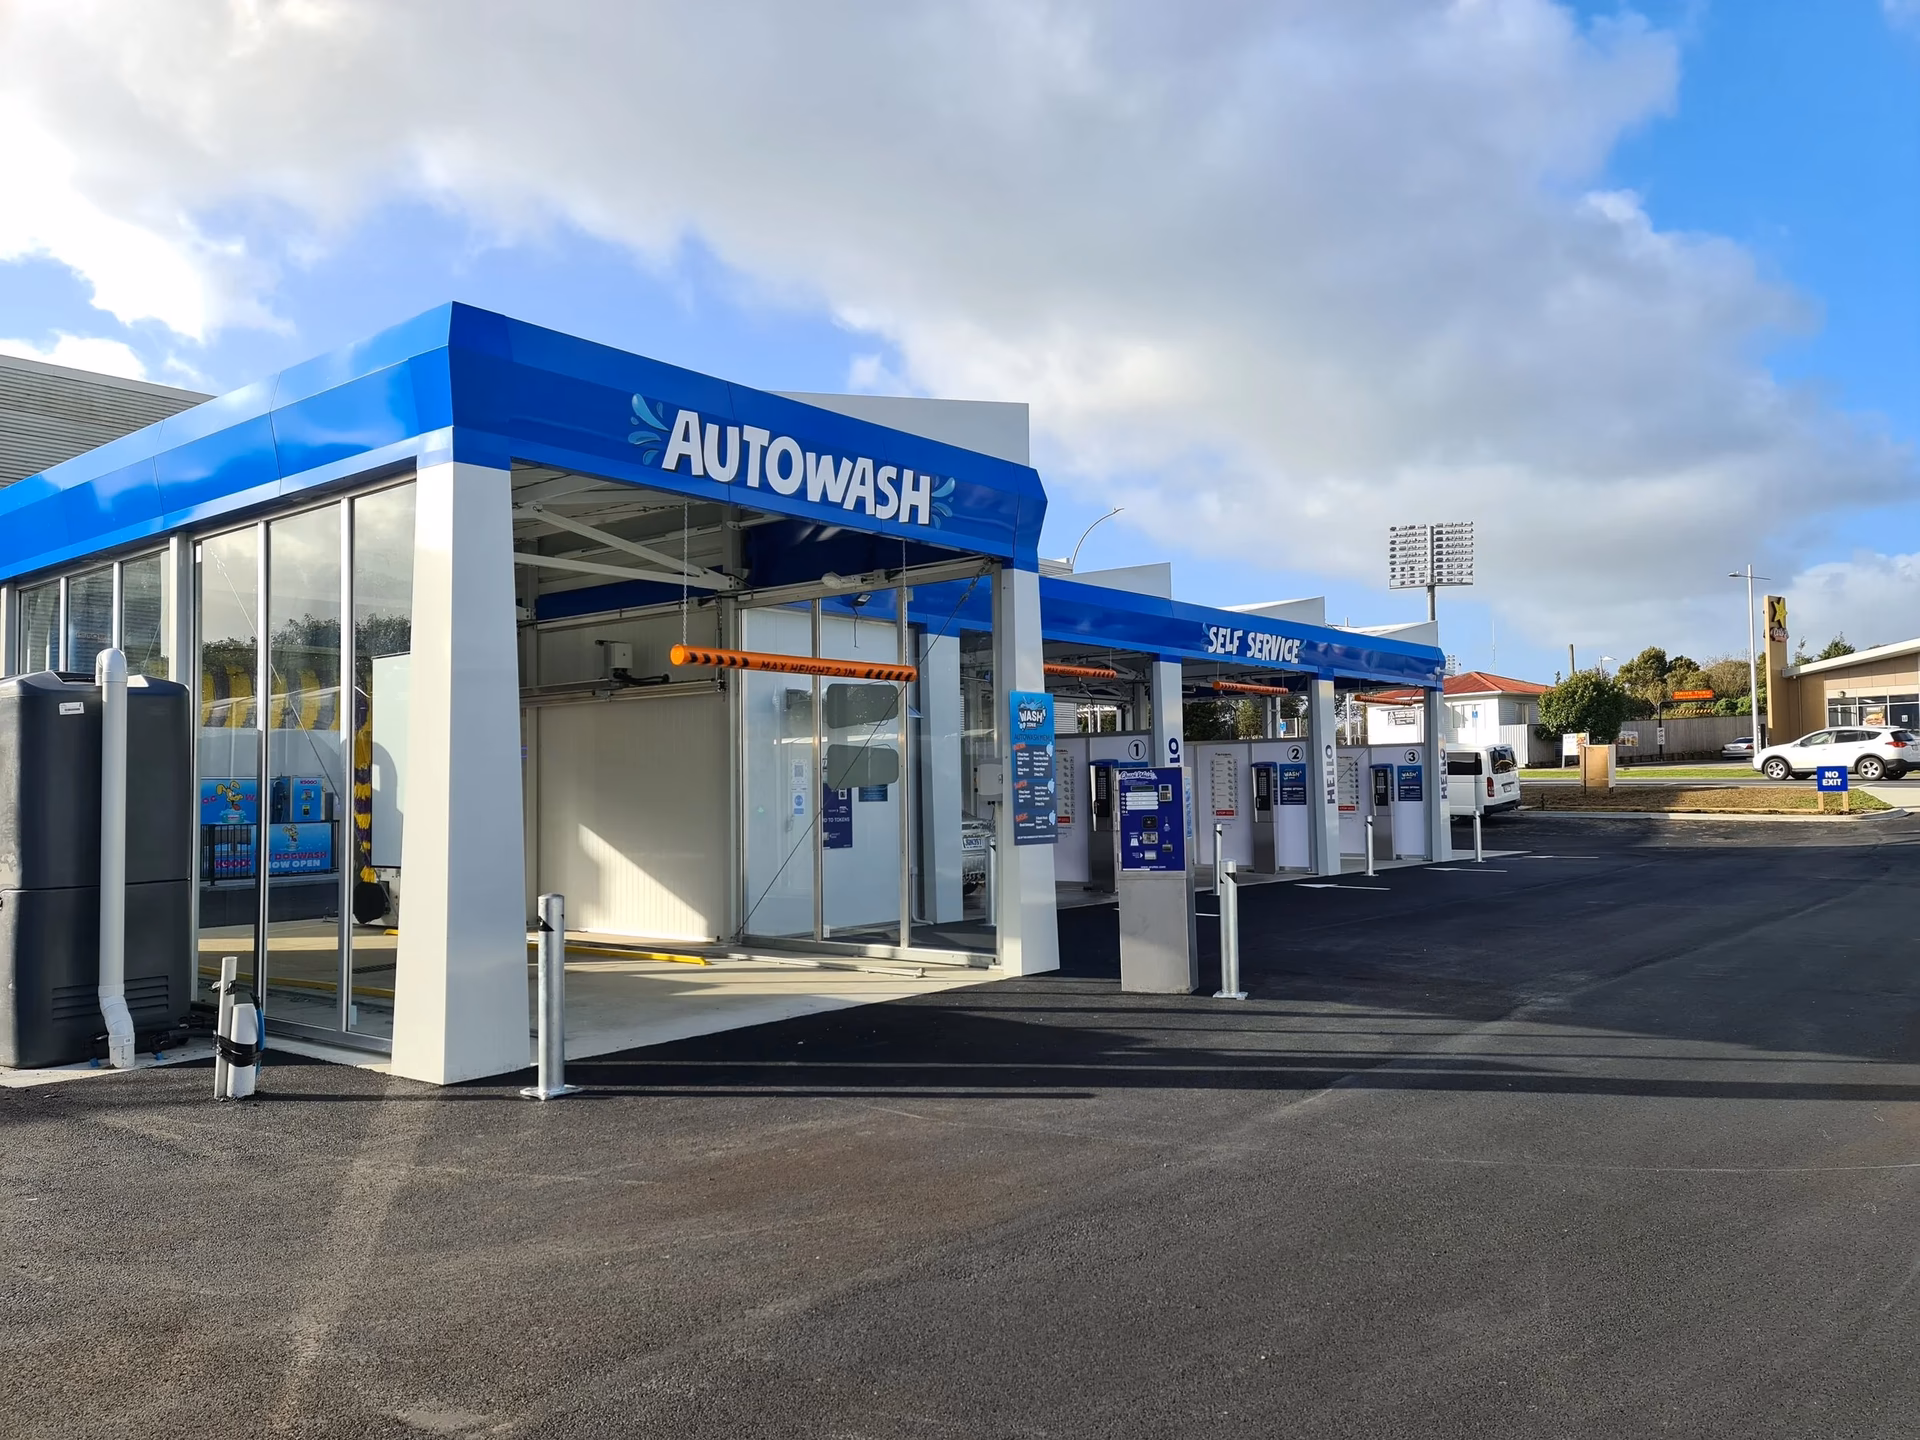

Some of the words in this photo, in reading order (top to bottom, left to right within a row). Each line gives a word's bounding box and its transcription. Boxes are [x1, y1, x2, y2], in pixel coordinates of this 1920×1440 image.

[661, 409, 931, 525] AUTOWASH
[1208, 626, 1243, 655] SELF
[1246, 631, 1300, 664] SERVICE
[760, 661, 787, 671] MAX
[790, 664, 831, 676] HEIGHT
[1019, 710, 1043, 723] WASH
[1133, 743, 1140, 757] 1
[1291, 748, 1300, 760] 2
[1408, 751, 1416, 762] 3
[1325, 744, 1337, 804] HELLO
[1439, 748, 1448, 799] HELLO
[275, 851, 327, 860] DOGWASH
[291, 859, 321, 868] OPEN
